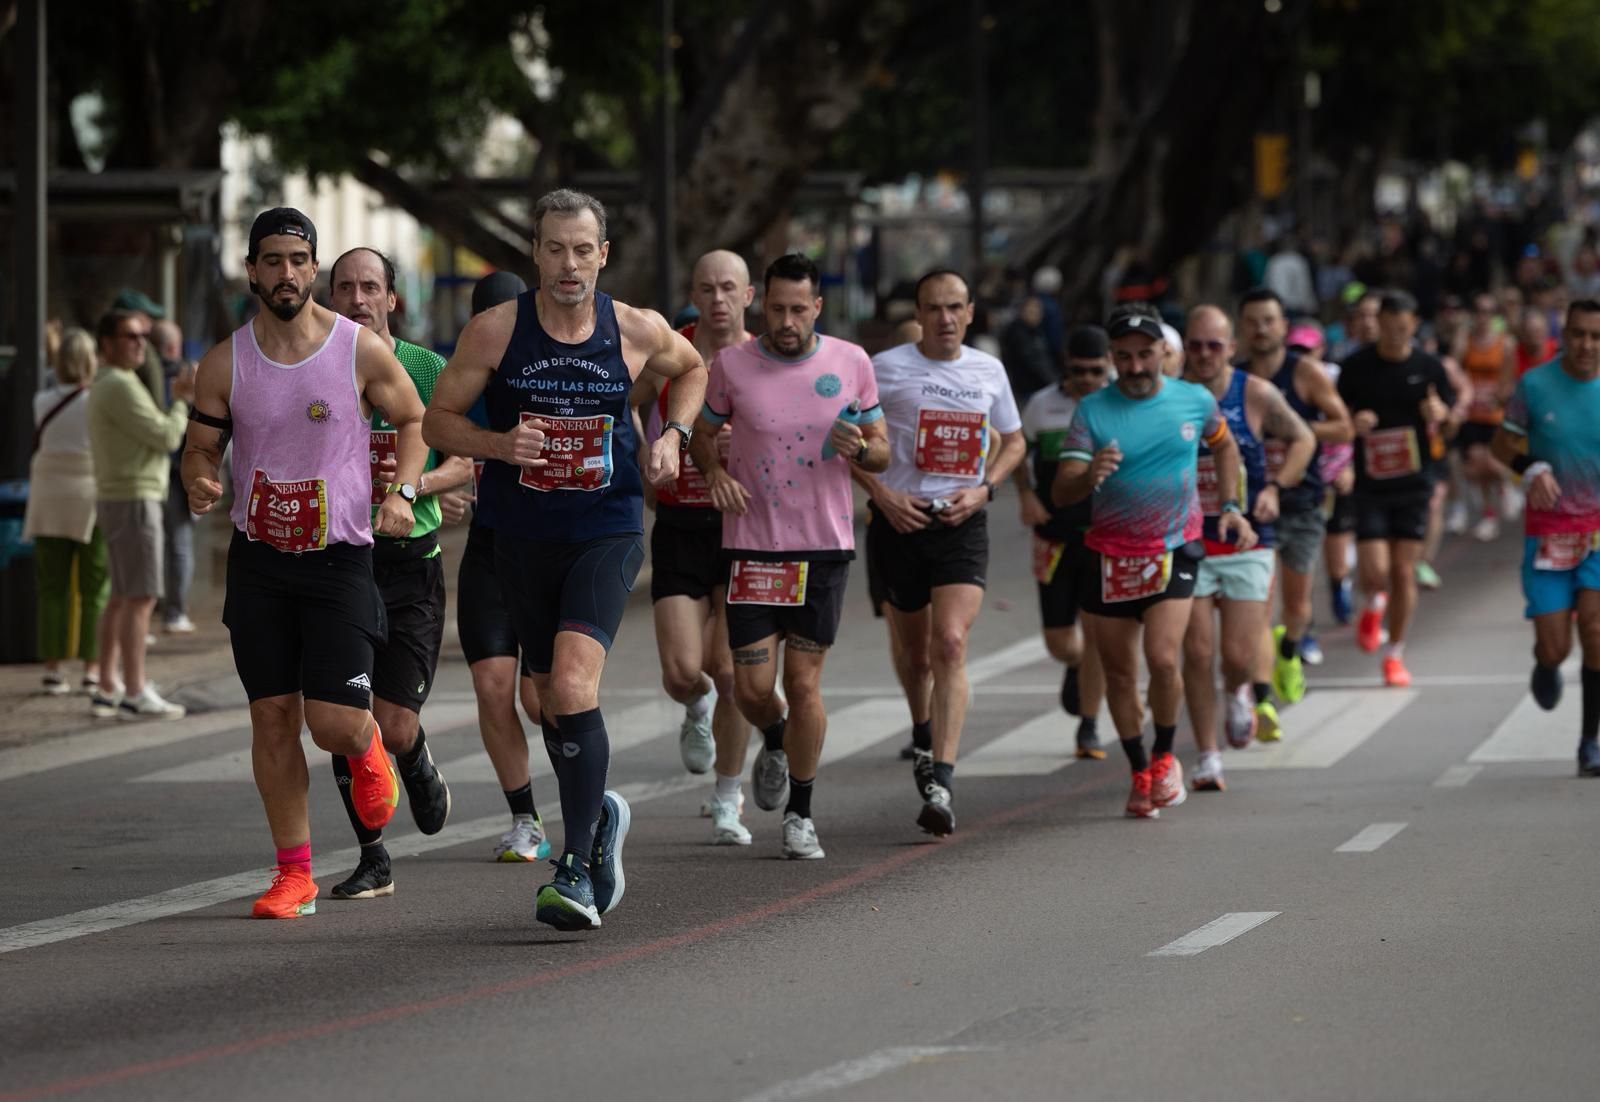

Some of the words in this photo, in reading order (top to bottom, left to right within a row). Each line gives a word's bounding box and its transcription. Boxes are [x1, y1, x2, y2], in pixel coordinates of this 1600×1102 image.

[522, 360, 550, 376] CLUB
[551, 357, 609, 379] DEPORTIVO
[506, 378, 558, 391] MIACUM
[562, 381, 584, 392] LAS
[587, 382, 625, 393] ROZAS
[531, 394, 571, 406] Running
[573, 396, 601, 406] Since
[933, 425, 970, 440] 4575
[542, 436, 584, 452] 4635
[272, 482, 313, 494] NERALI
